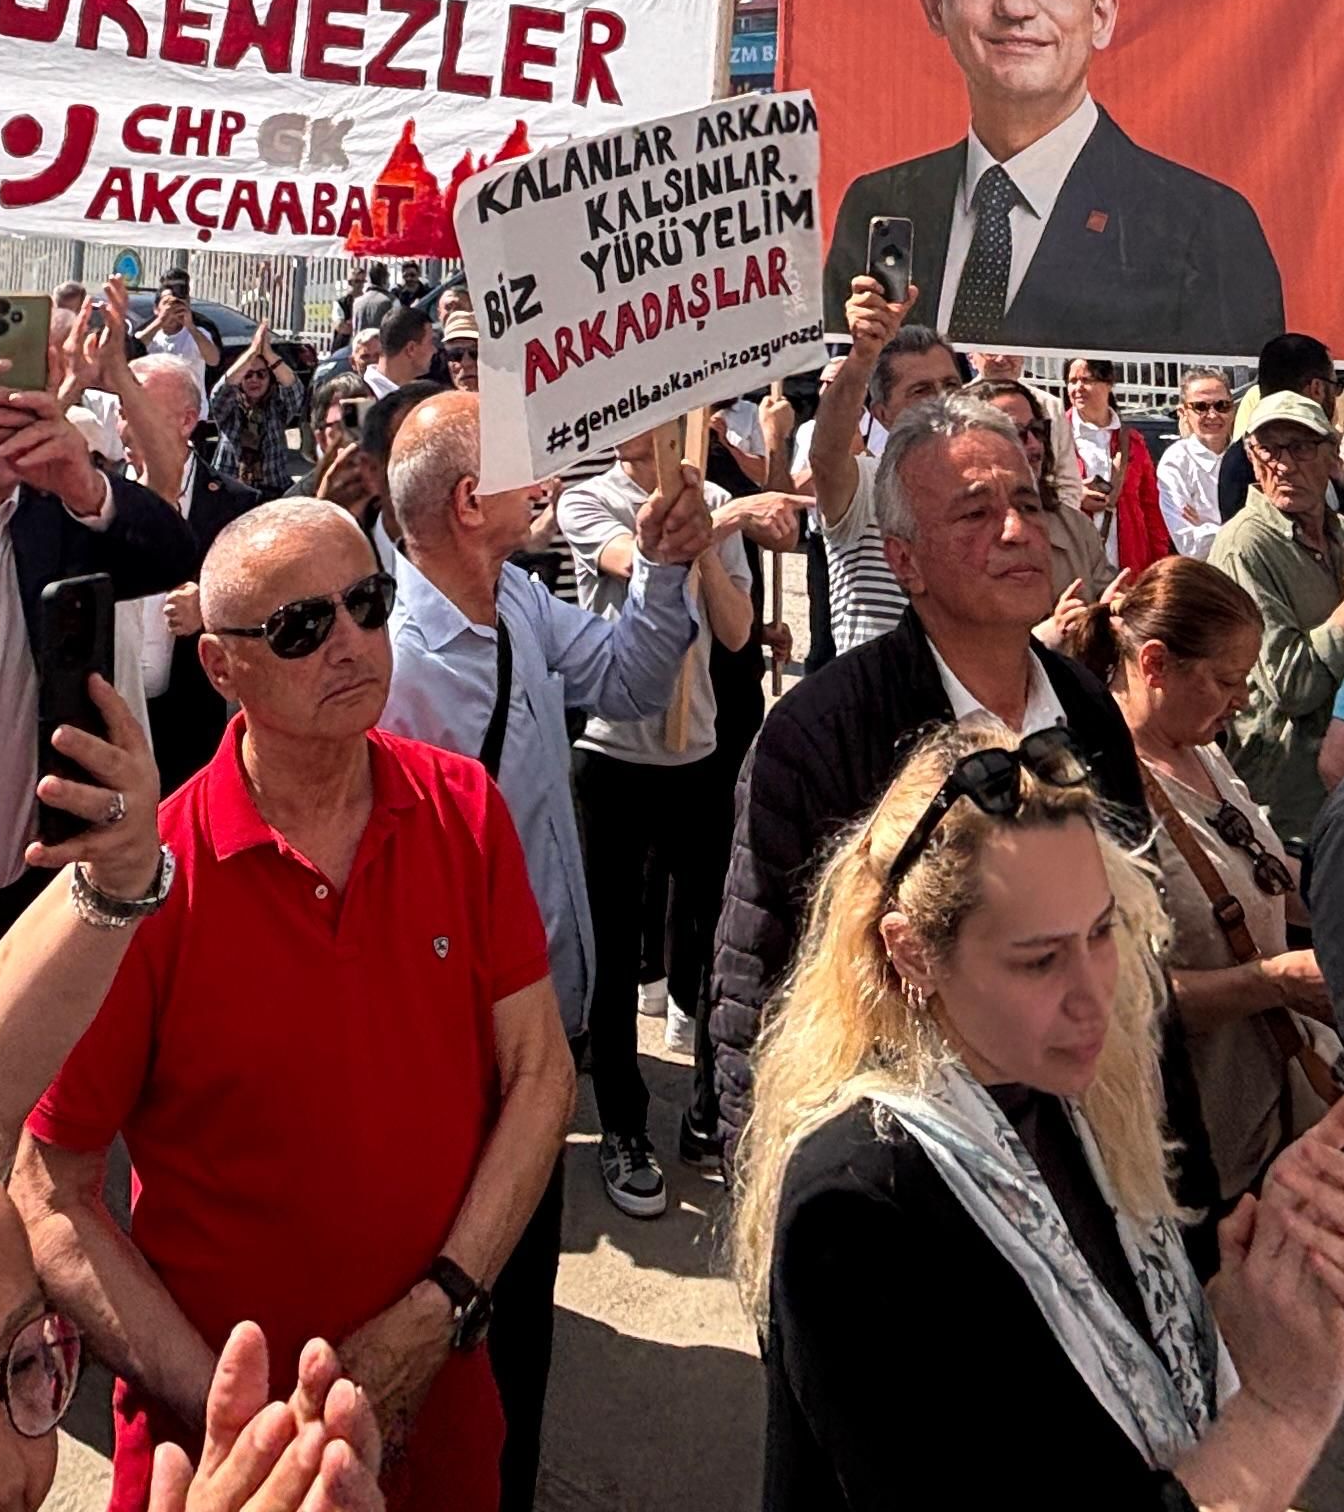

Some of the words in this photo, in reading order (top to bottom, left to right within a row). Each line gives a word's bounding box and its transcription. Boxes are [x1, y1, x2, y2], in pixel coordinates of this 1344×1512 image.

[121, 103, 246, 156] CHP
[476, 125, 676, 224] KALANLAR
[696, 99, 819, 153] ARKADA
[84, 166, 416, 243] AKÇAABAT
[484, 272, 544, 339] BİZ
[579, 187, 814, 294] YÜRÜYELİM
[524, 246, 793, 396] ARKADAŞLAR
